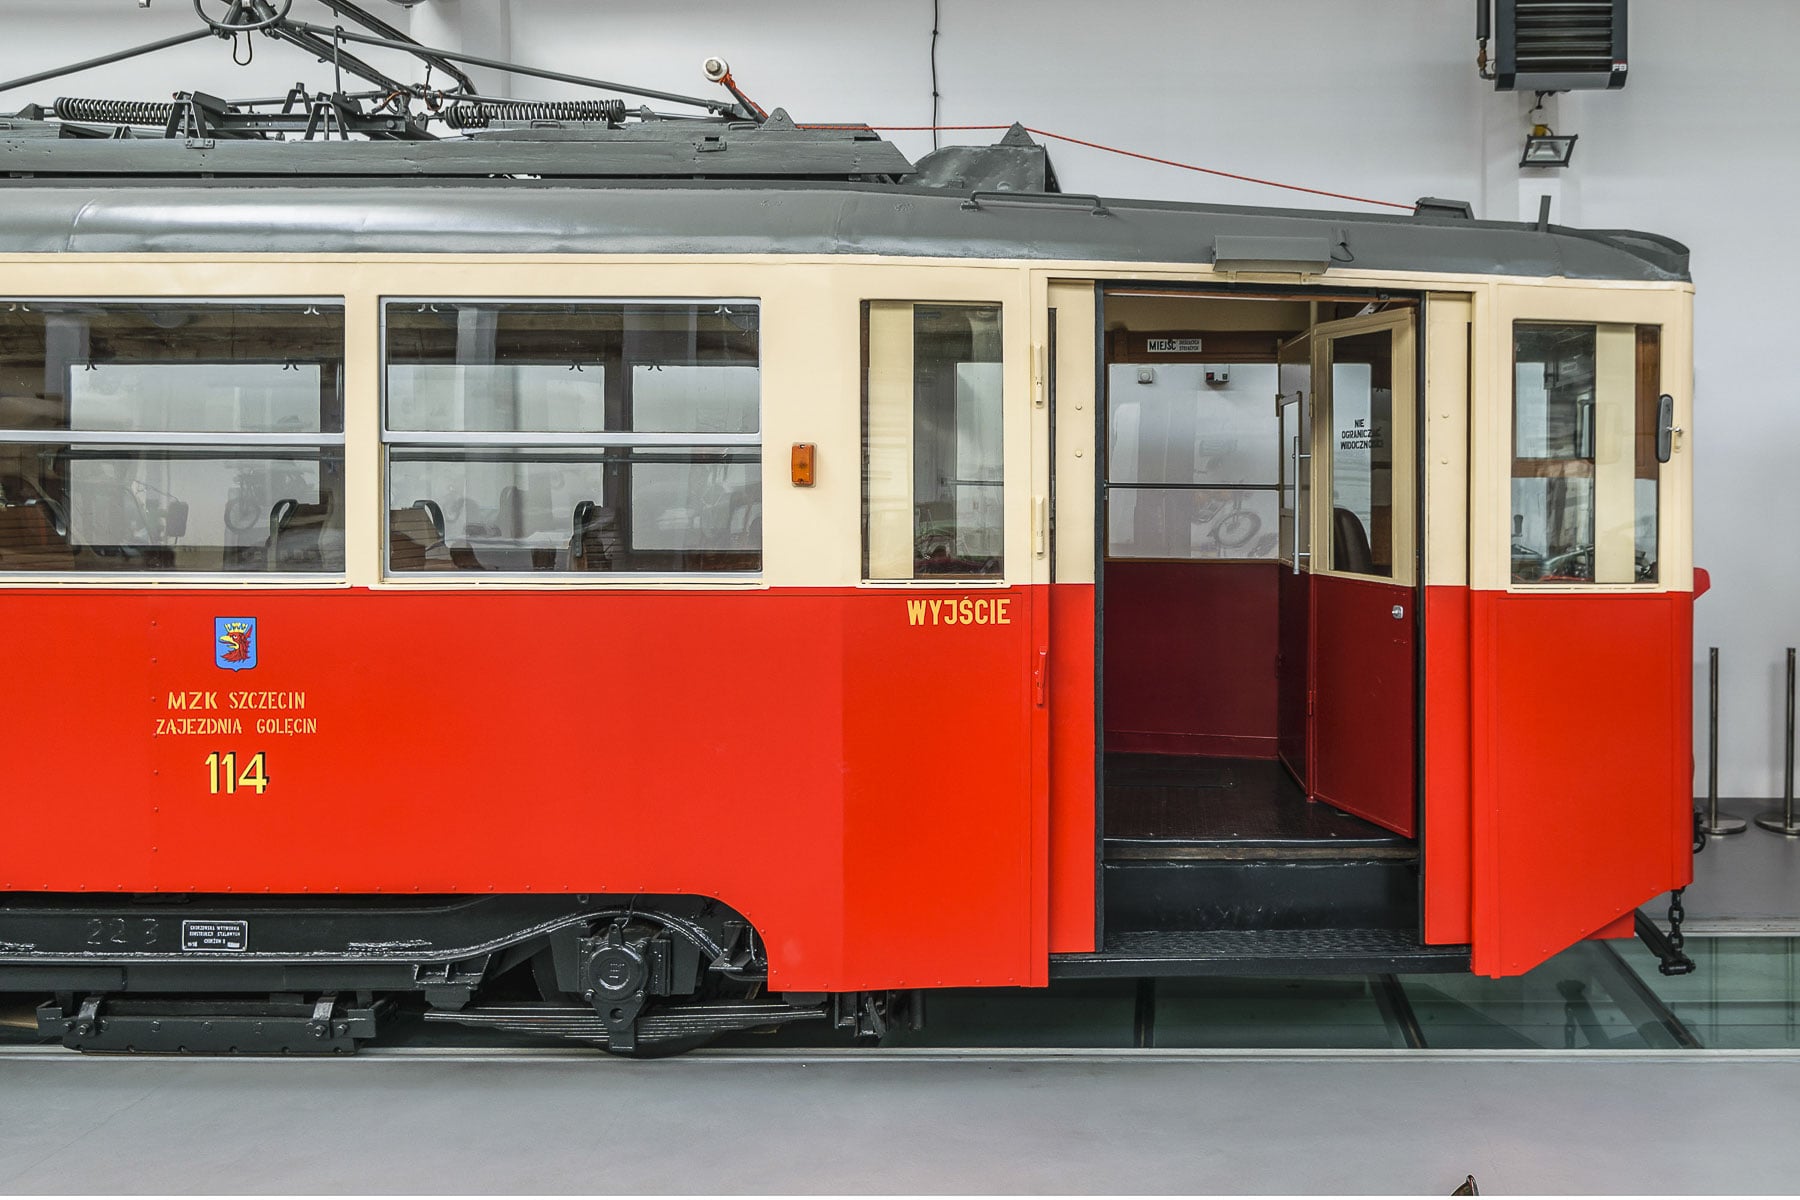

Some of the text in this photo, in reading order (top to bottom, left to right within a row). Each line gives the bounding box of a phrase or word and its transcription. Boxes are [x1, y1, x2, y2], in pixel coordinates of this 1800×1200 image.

[907, 596, 1011, 626] WYJŚCIE
[167, 691, 306, 710] MZK SZCZECIN
[156, 718, 317, 737] ZAJEZDNIA GOLĘCIN
[204, 751, 270, 794] 114
